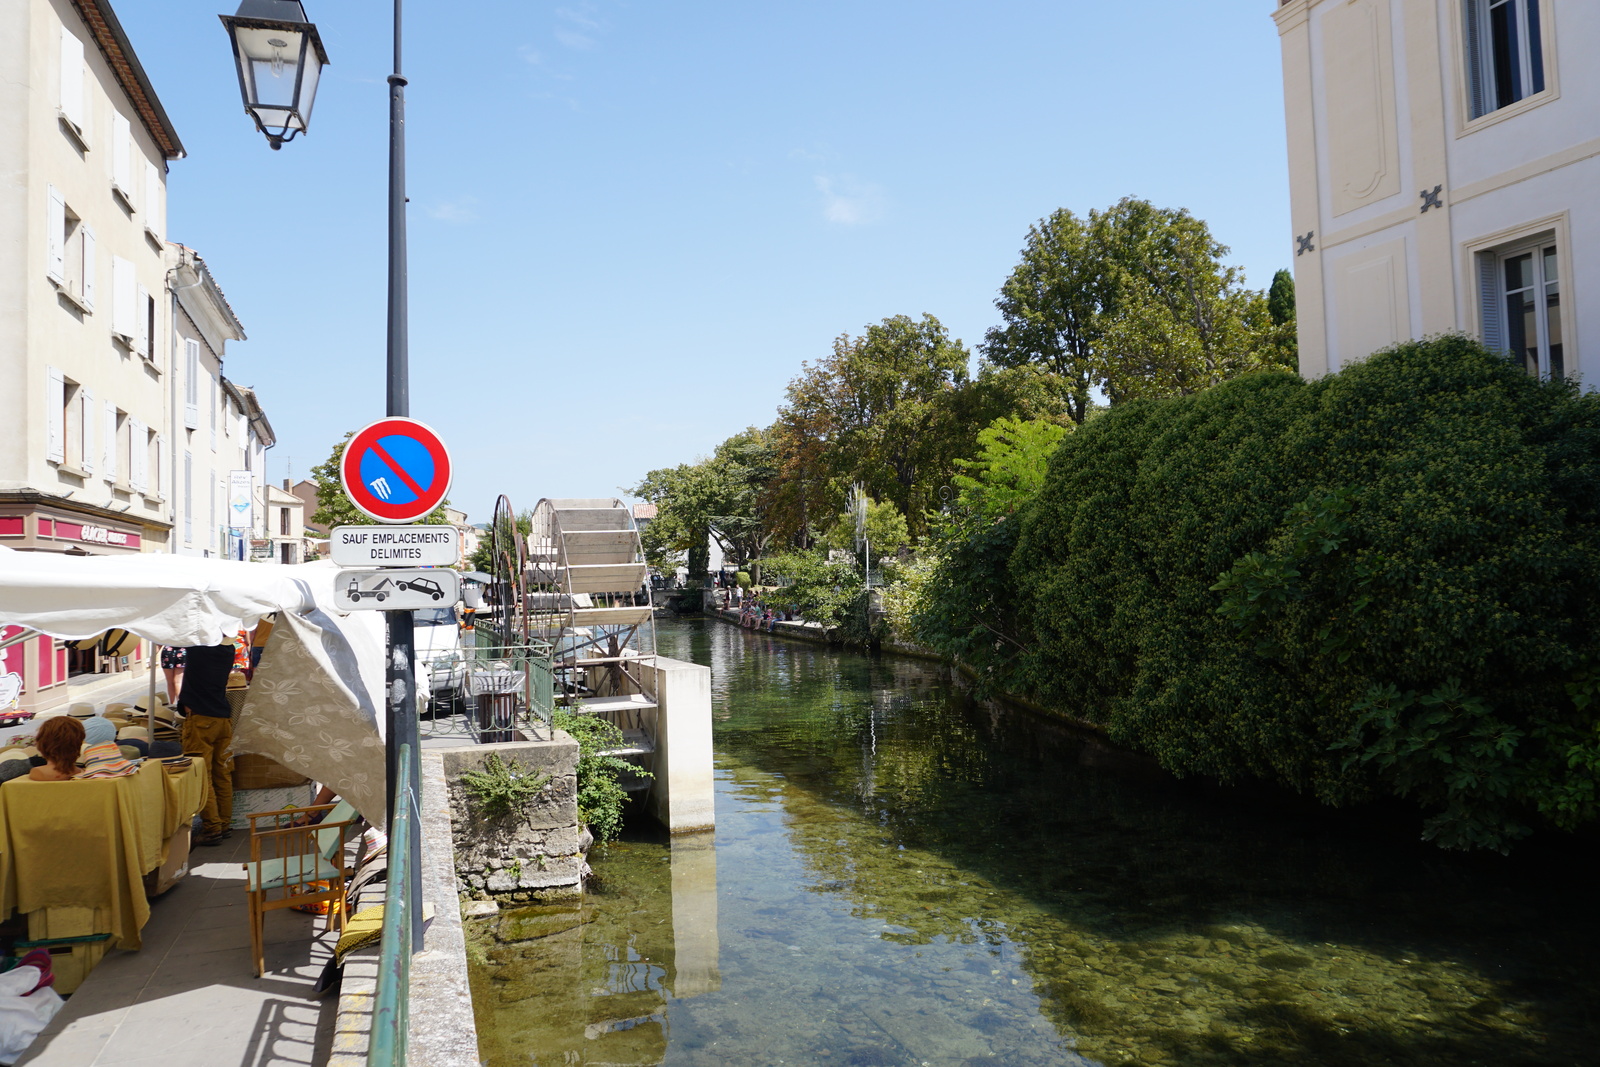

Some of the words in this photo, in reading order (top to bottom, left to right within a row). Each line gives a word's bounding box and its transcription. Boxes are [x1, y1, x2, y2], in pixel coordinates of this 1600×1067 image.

[342, 533, 368, 545] SAUF
[372, 532, 450, 544] EMPLACEMENTS
[370, 548, 422, 559] DELIMITES
